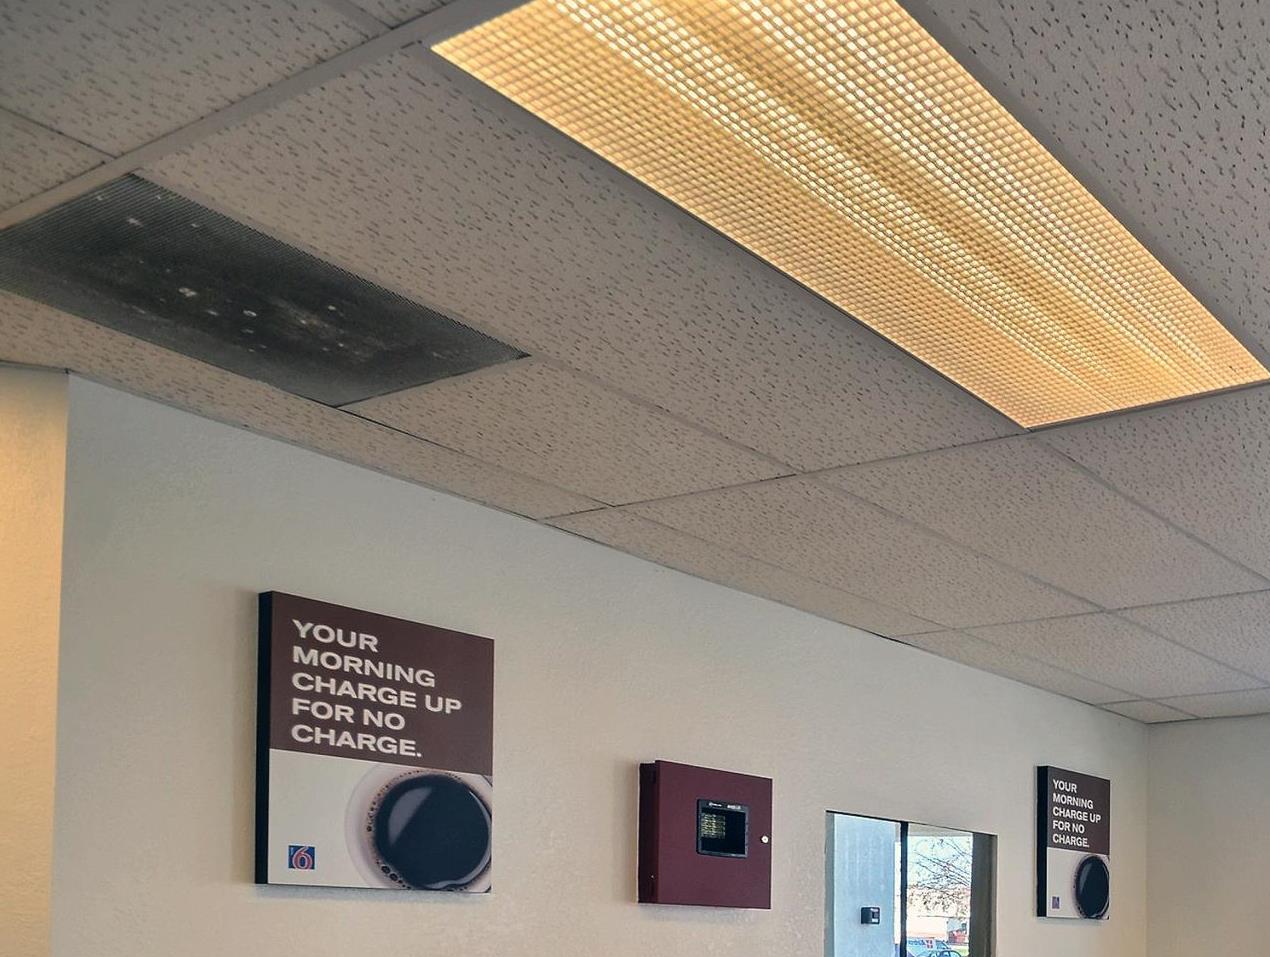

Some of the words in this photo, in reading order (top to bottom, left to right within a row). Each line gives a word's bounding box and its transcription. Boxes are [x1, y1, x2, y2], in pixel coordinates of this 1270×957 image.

[291, 618, 379, 653] YOUR
[292, 645, 436, 688] MORNING
[291, 672, 417, 709] CHARGE
[424, 694, 462, 715] UP
[291, 697, 355, 724] FOR
[363, 708, 406, 731] NO
[291, 723, 423, 758] CHARGE.
[1052, 779, 1077, 793] YOUR
[1052, 793, 1094, 809] MORNING
[1052, 806, 1088, 821] CHARGE
[1090, 813, 1101, 823] UP
[1052, 820, 1071, 831] FOR
[1072, 824, 1085, 833] NO
[1052, 834, 1090, 847] CHARGE.
[292, 845, 314, 870] 6
